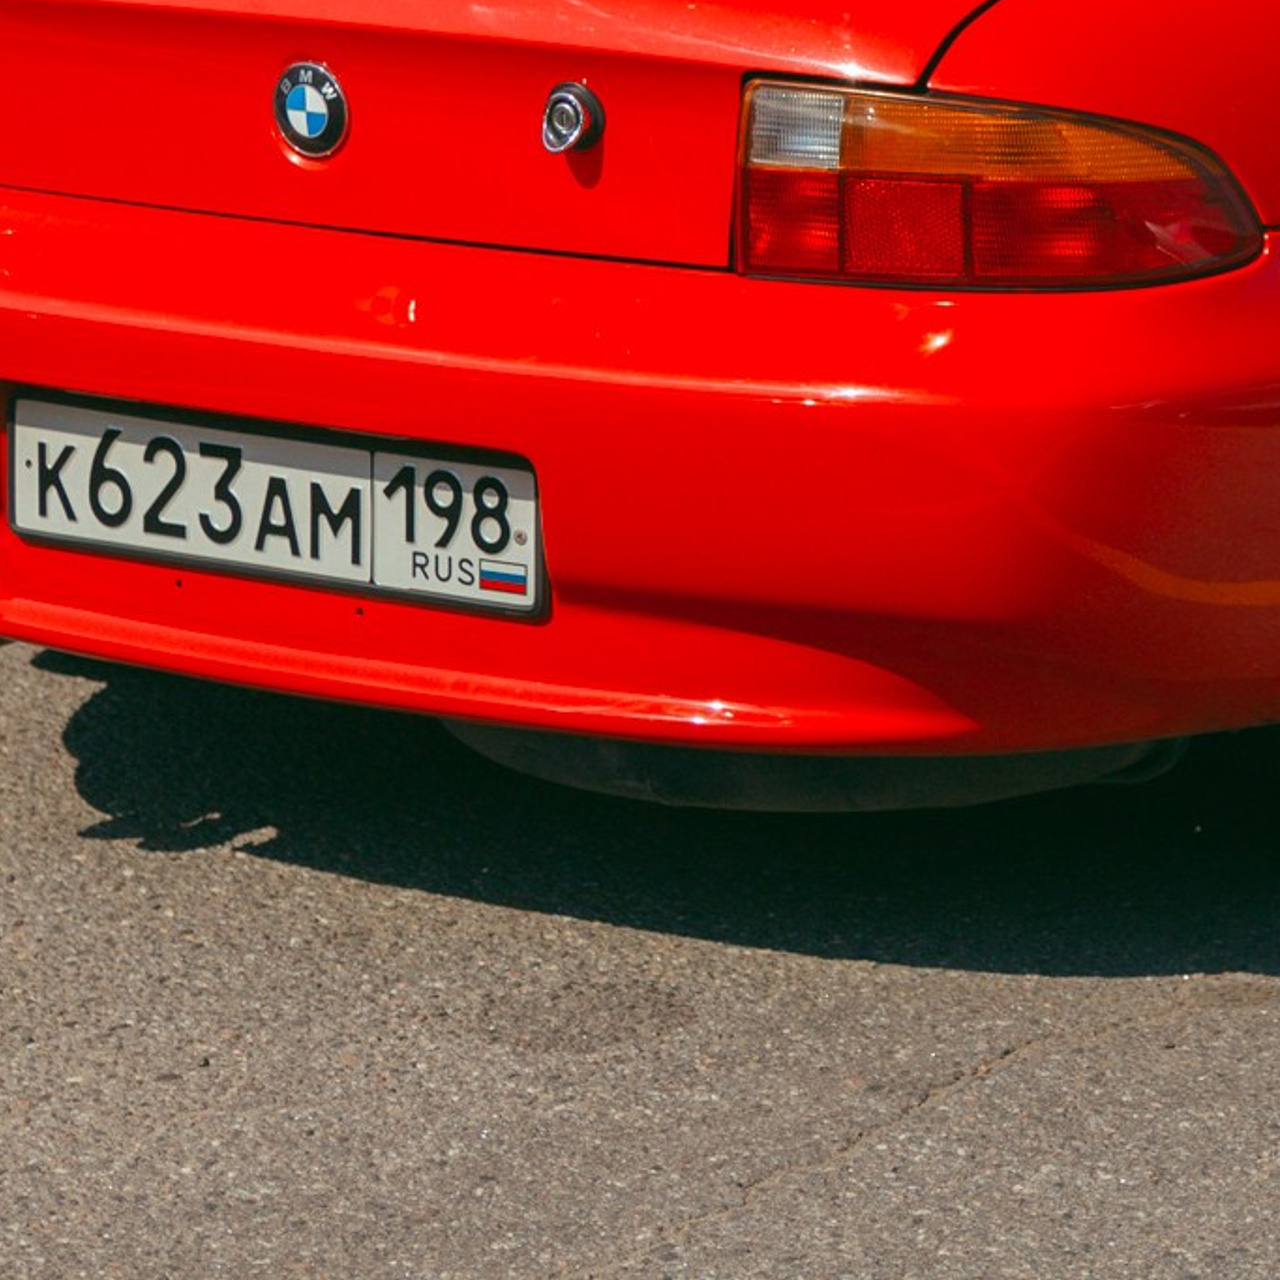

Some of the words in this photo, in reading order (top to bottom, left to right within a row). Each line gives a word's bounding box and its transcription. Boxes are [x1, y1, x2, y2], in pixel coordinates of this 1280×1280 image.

[280, 68, 338, 100] BMW
[37, 428, 362, 566] K623AM
[383, 465, 512, 555] 198
[410, 551, 476, 587] RUS
